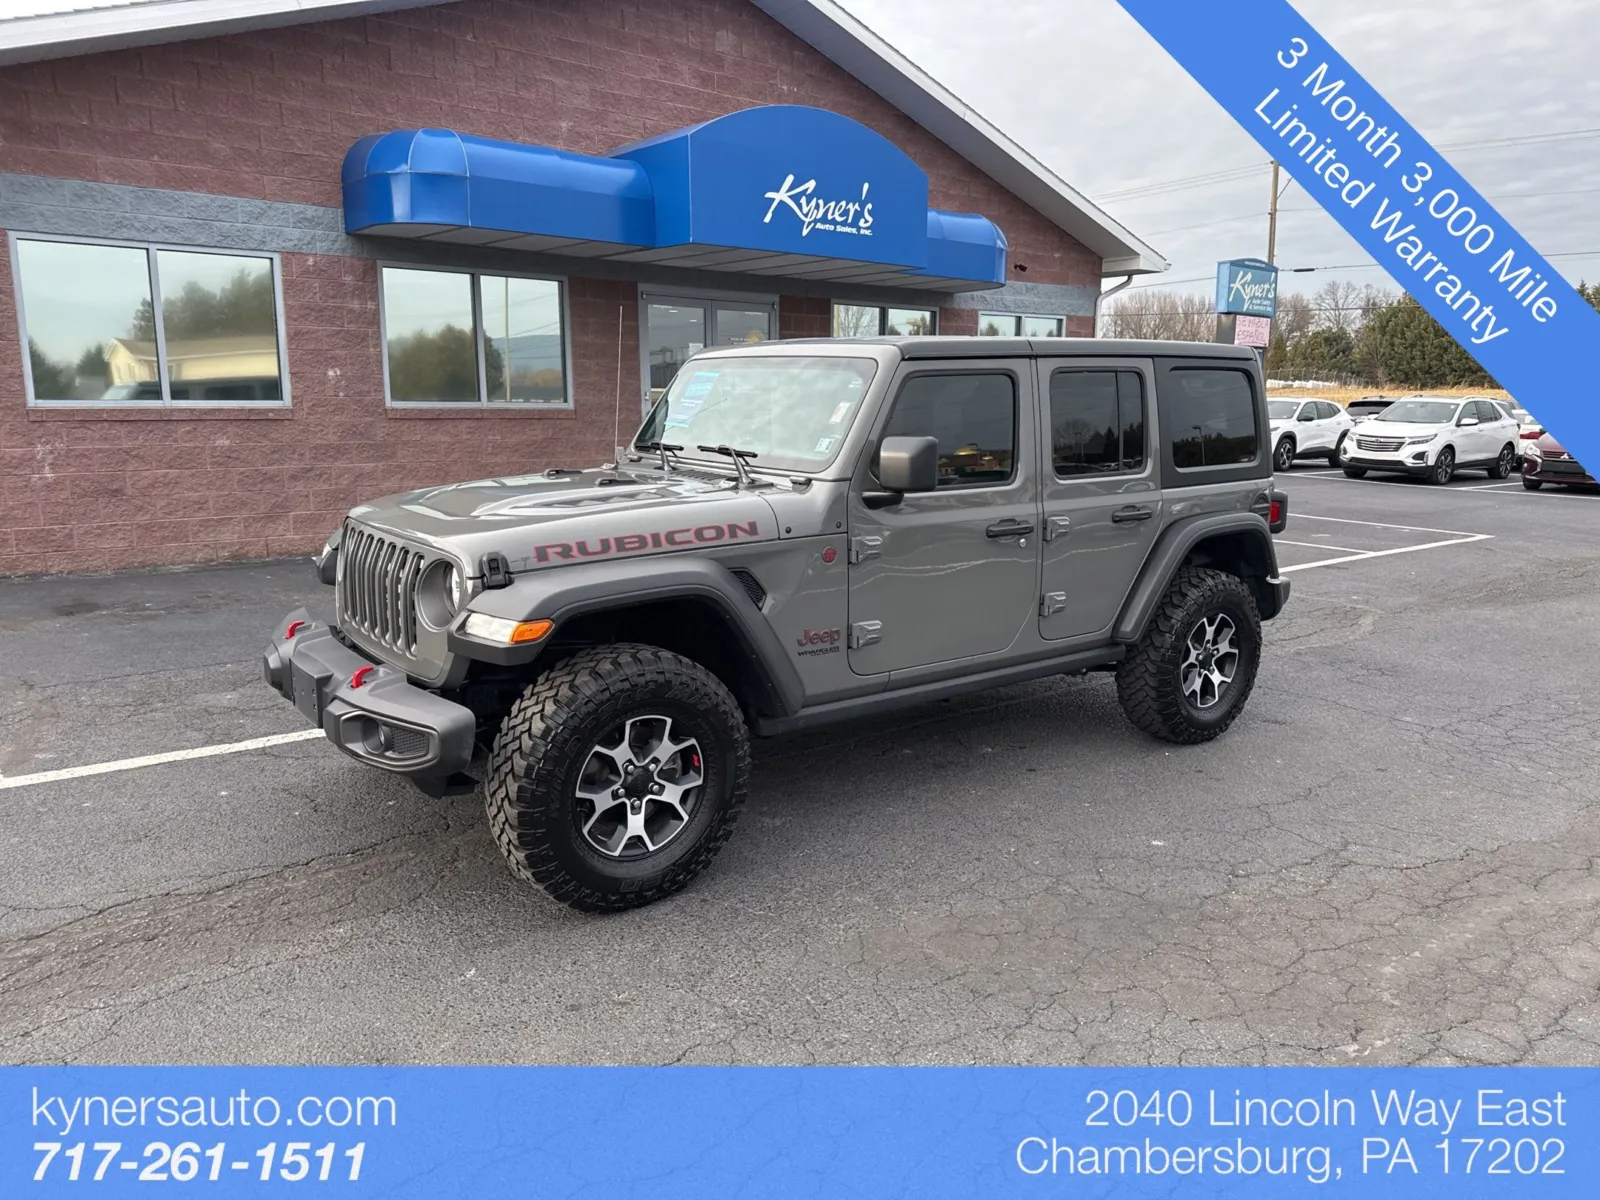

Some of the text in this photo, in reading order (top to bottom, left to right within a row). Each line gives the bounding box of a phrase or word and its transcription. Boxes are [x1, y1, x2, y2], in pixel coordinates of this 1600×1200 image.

[763, 173, 874, 237] Kyner's
[814, 222, 873, 236] Auto Sales, Inc.
[1229, 270, 1275, 312] Kyner's
[534, 521, 759, 563] RUBICON
[796, 627, 841, 646] Jeep
